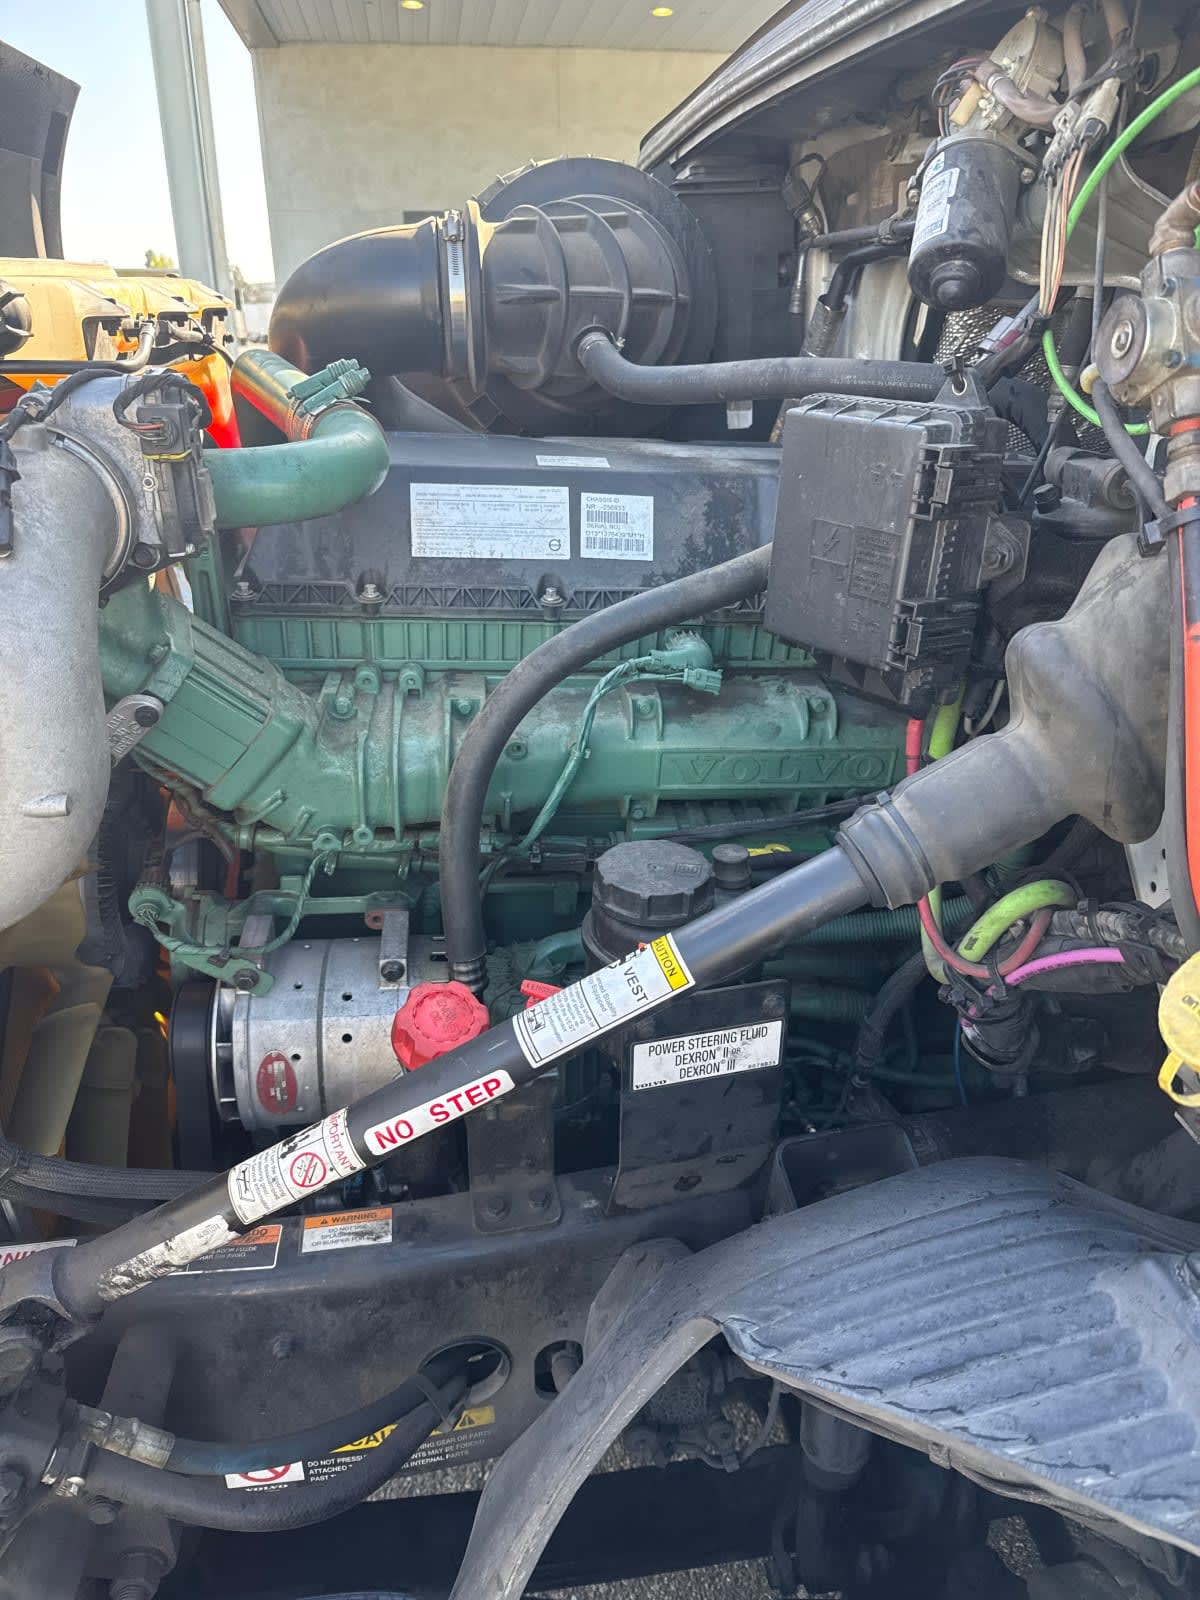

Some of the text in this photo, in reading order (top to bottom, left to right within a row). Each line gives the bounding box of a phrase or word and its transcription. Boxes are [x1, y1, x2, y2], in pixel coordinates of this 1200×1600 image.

[671, 754, 886, 785] VOLVO
[653, 938, 677, 977] AUTION
[623, 966, 649, 1003] VEST
[649, 1026, 768, 1056] POWER STEERING FLUID
[635, 1079, 666, 1089] VOLVO
[374, 1078, 501, 1149] NO STEP
[332, 1212, 377, 1224] WARNING
[309, 1465, 347, 1475] ATTACHED
[411, 1457, 445, 1466] INTERNAL
